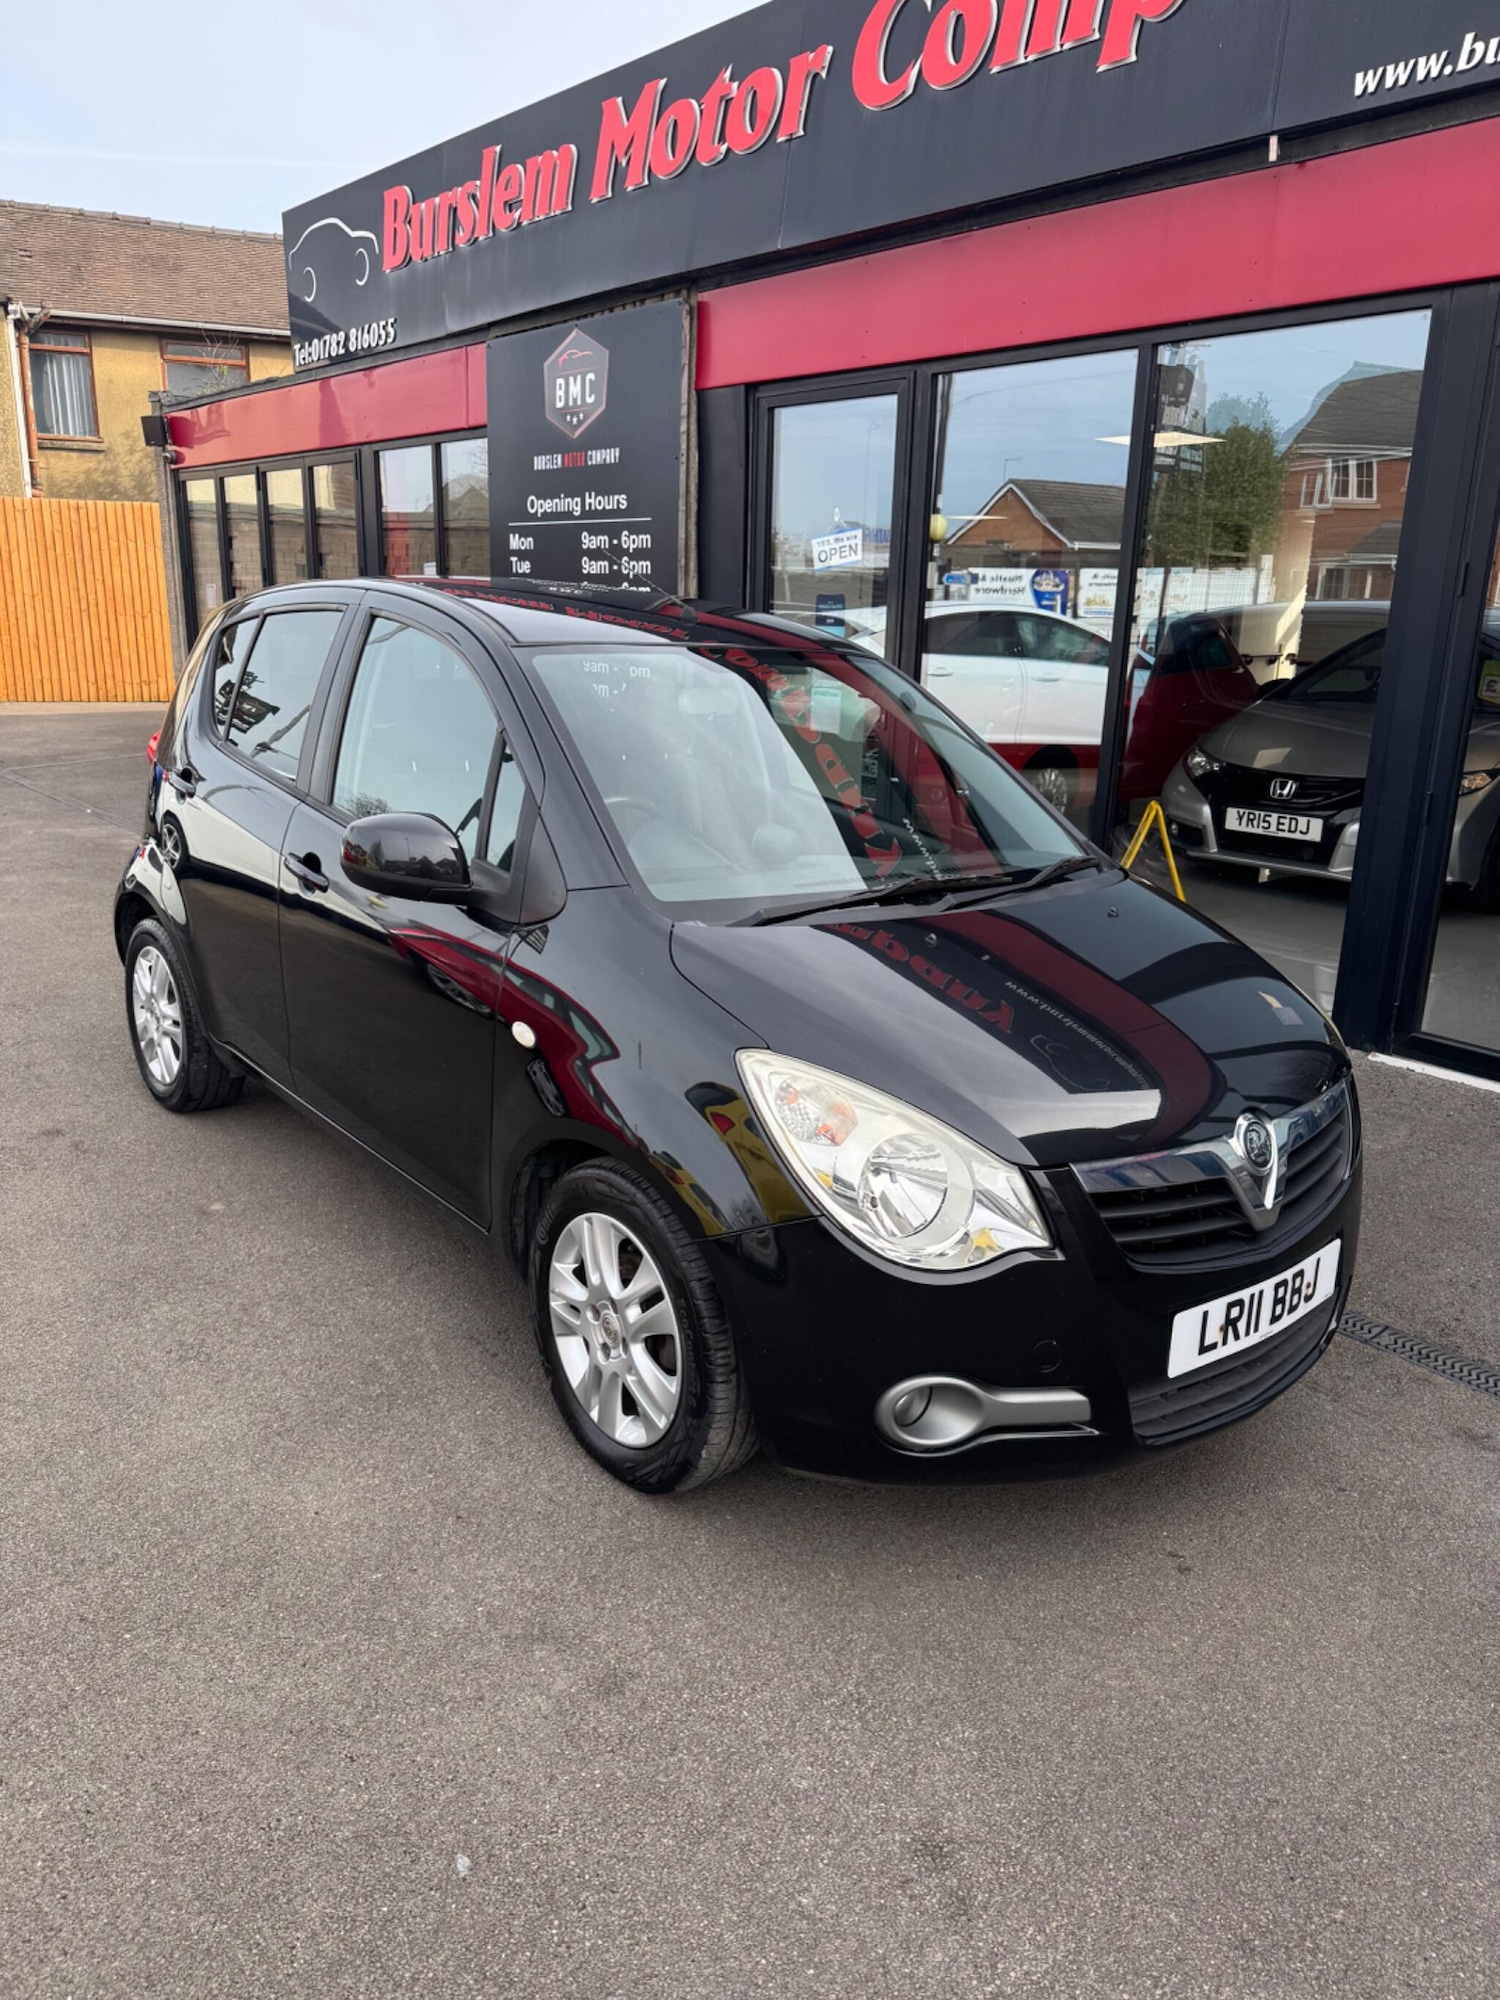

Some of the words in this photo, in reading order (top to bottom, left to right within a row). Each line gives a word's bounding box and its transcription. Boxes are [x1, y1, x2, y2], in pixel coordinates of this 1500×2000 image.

[383, 144, 578, 272] Burslem
[589, 44, 834, 203] Motor
[294, 331, 346, 366] Tel:01782
[349, 318, 396, 352] 816055
[555, 372, 596, 409] BMC
[587, 447, 620, 466] COMPANY
[526, 493, 581, 518] Opening
[585, 491, 628, 511] Hours
[509, 533, 534, 550] Mon
[581, 531, 609, 549] 9am
[621, 530, 651, 553] 6pm
[817, 543, 859, 563] OPEN
[510, 556, 532, 574] Tue
[581, 556, 609, 574] 9am
[1236, 810, 1272, 831] YR15
[1276, 815, 1311, 835] EDJ
[1198, 1289, 1264, 1356] LR11
[1269, 1256, 1321, 1326] BBJ
